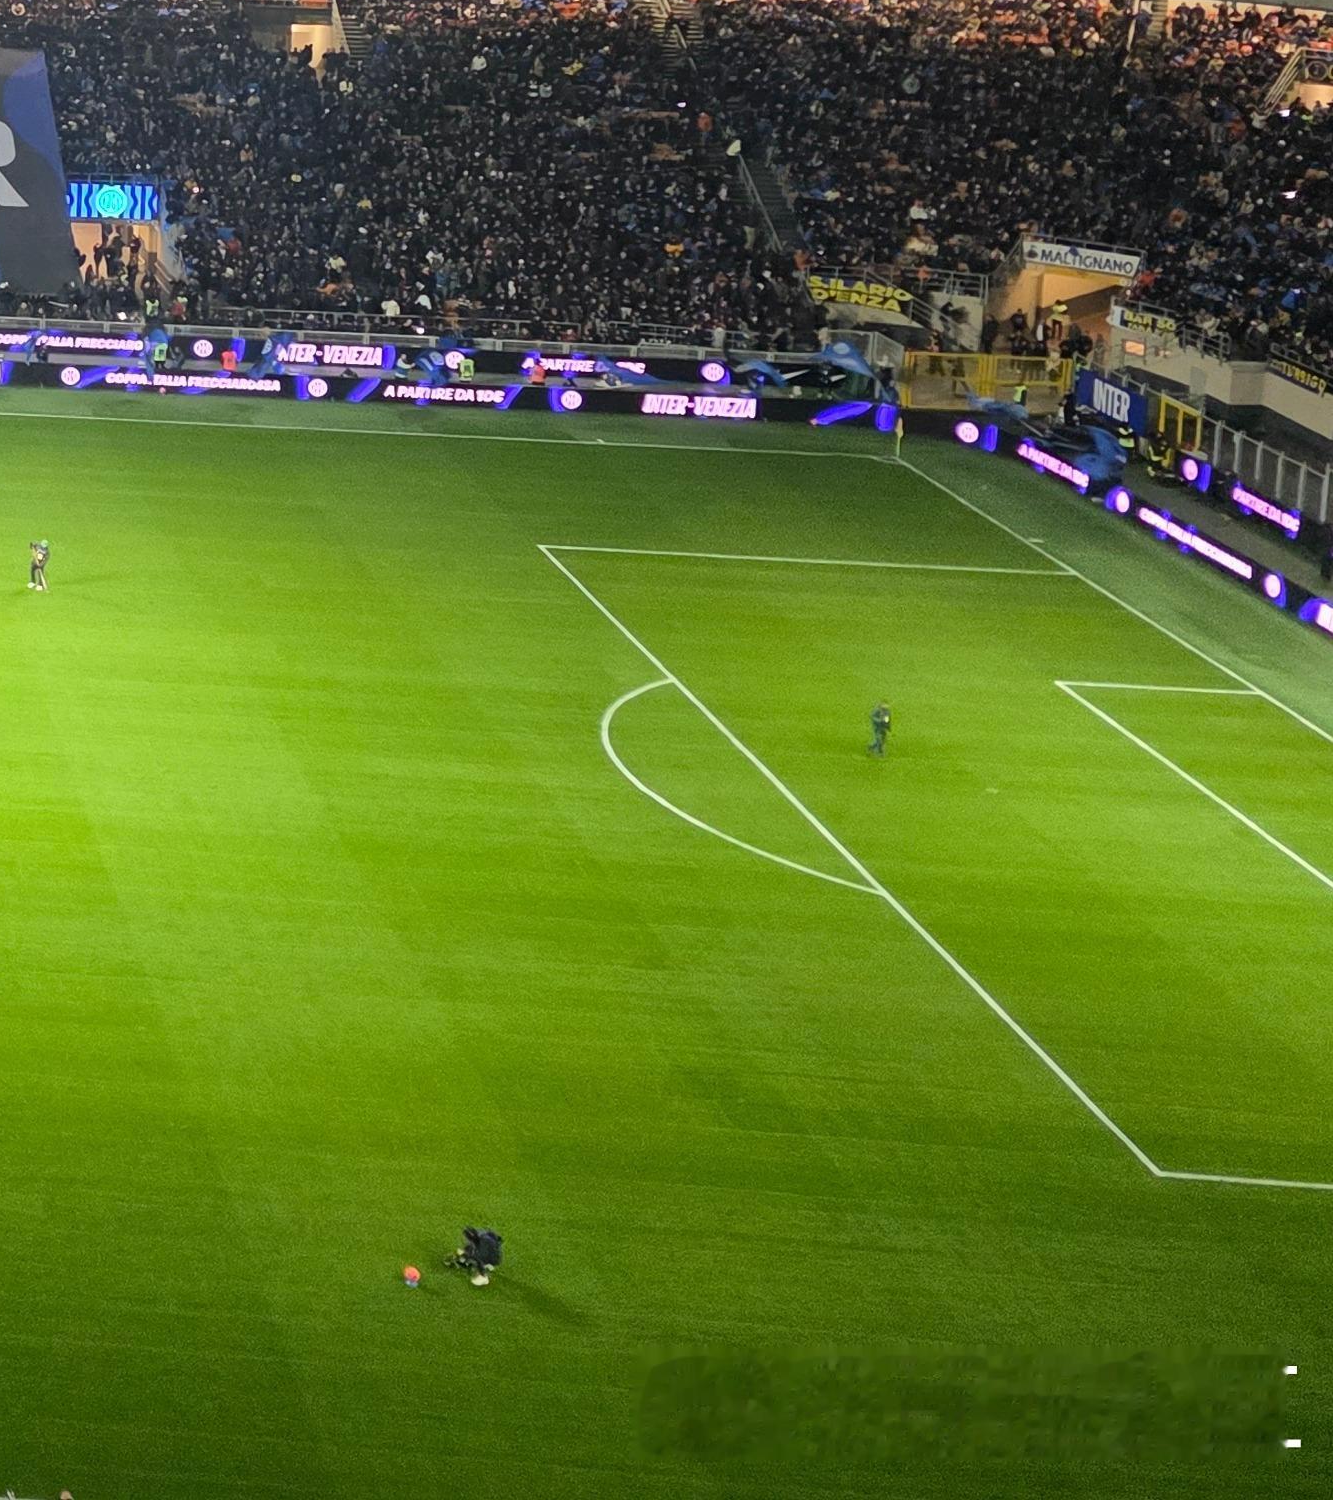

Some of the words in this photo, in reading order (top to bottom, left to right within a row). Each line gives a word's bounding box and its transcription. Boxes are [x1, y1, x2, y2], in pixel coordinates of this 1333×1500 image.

[1040, 248, 1134, 273] MALTIGNANO
[811, 289, 902, 313] D'ENZA
[383, 384, 396, 397] A
[453, 388, 474, 401] DA
[1092, 379, 1131, 423] INTER
